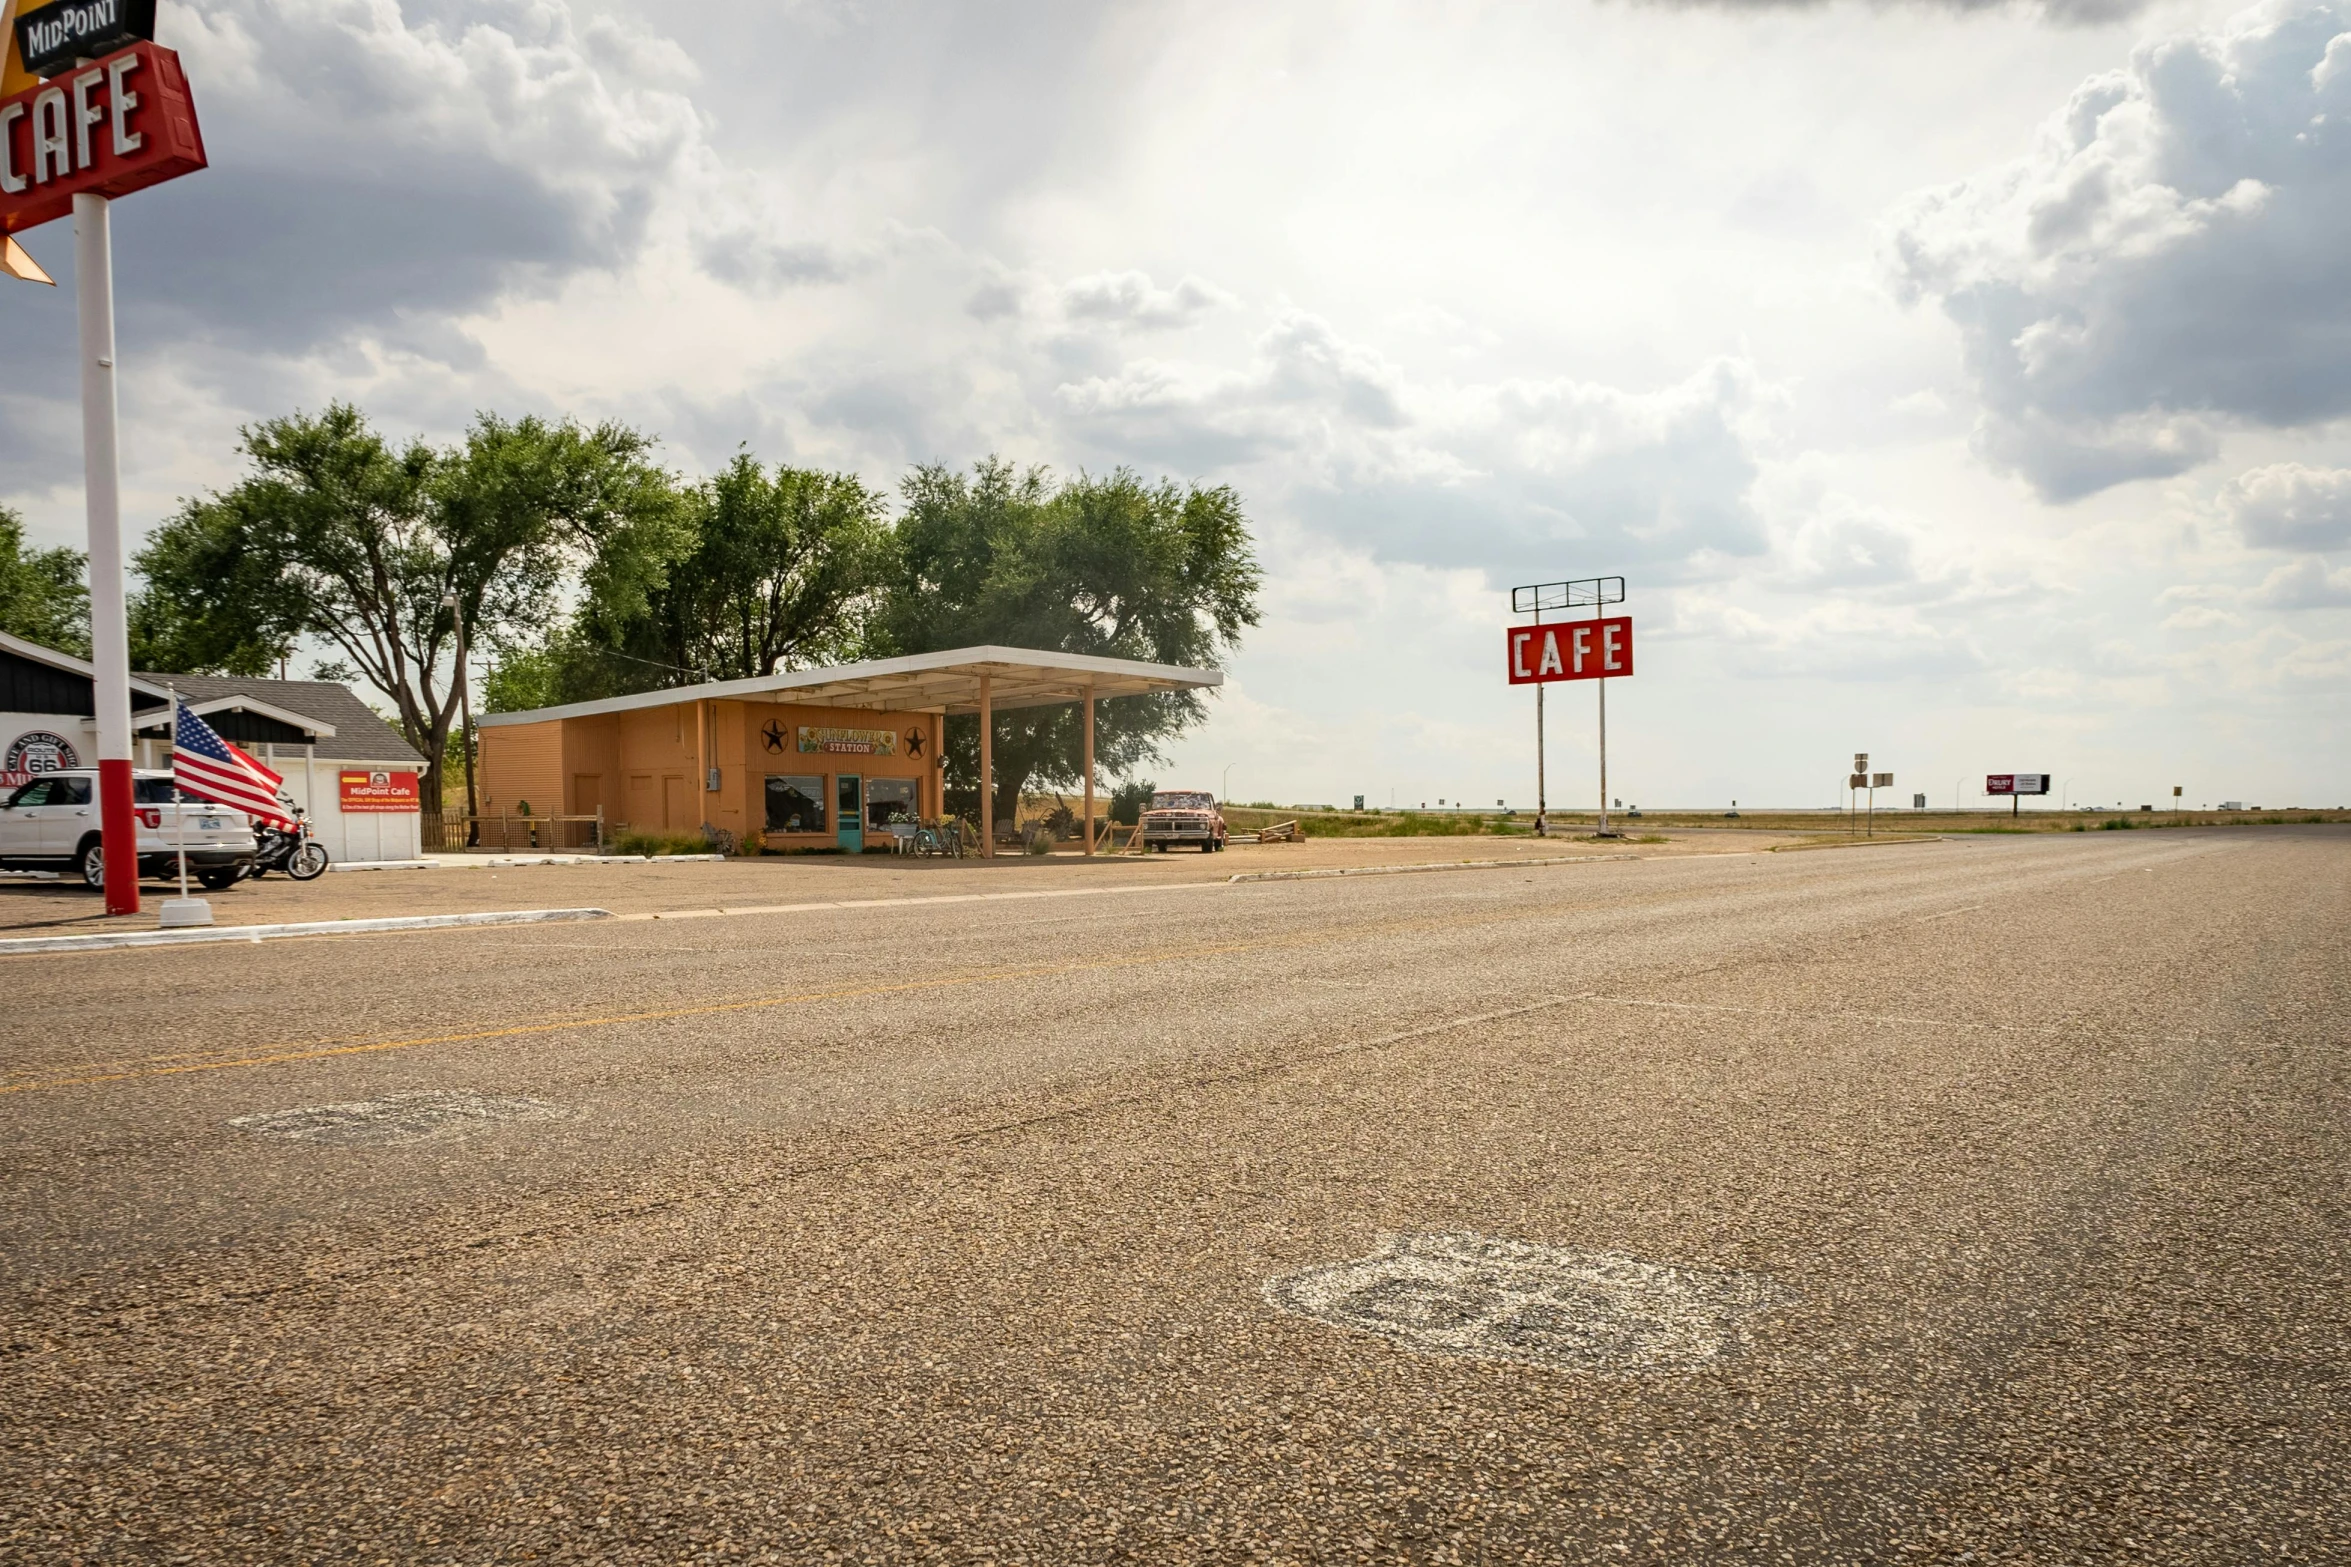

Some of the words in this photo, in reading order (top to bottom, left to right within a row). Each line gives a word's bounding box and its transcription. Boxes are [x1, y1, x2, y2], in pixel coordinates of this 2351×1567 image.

[0, 52, 142, 194] CAFE
[1513, 624, 1622, 678] CAFE
[816, 727, 882, 743] SUNFLOWER
[18, 734, 39, 749] AND
[41, 734, 65, 748] GIFT
[64, 747, 77, 767] SHO
[829, 743, 870, 752] STATION
[29, 760, 57, 772] 66
[350, 787, 389, 795] MidPoint
[391, 787, 410, 795] Cafe
